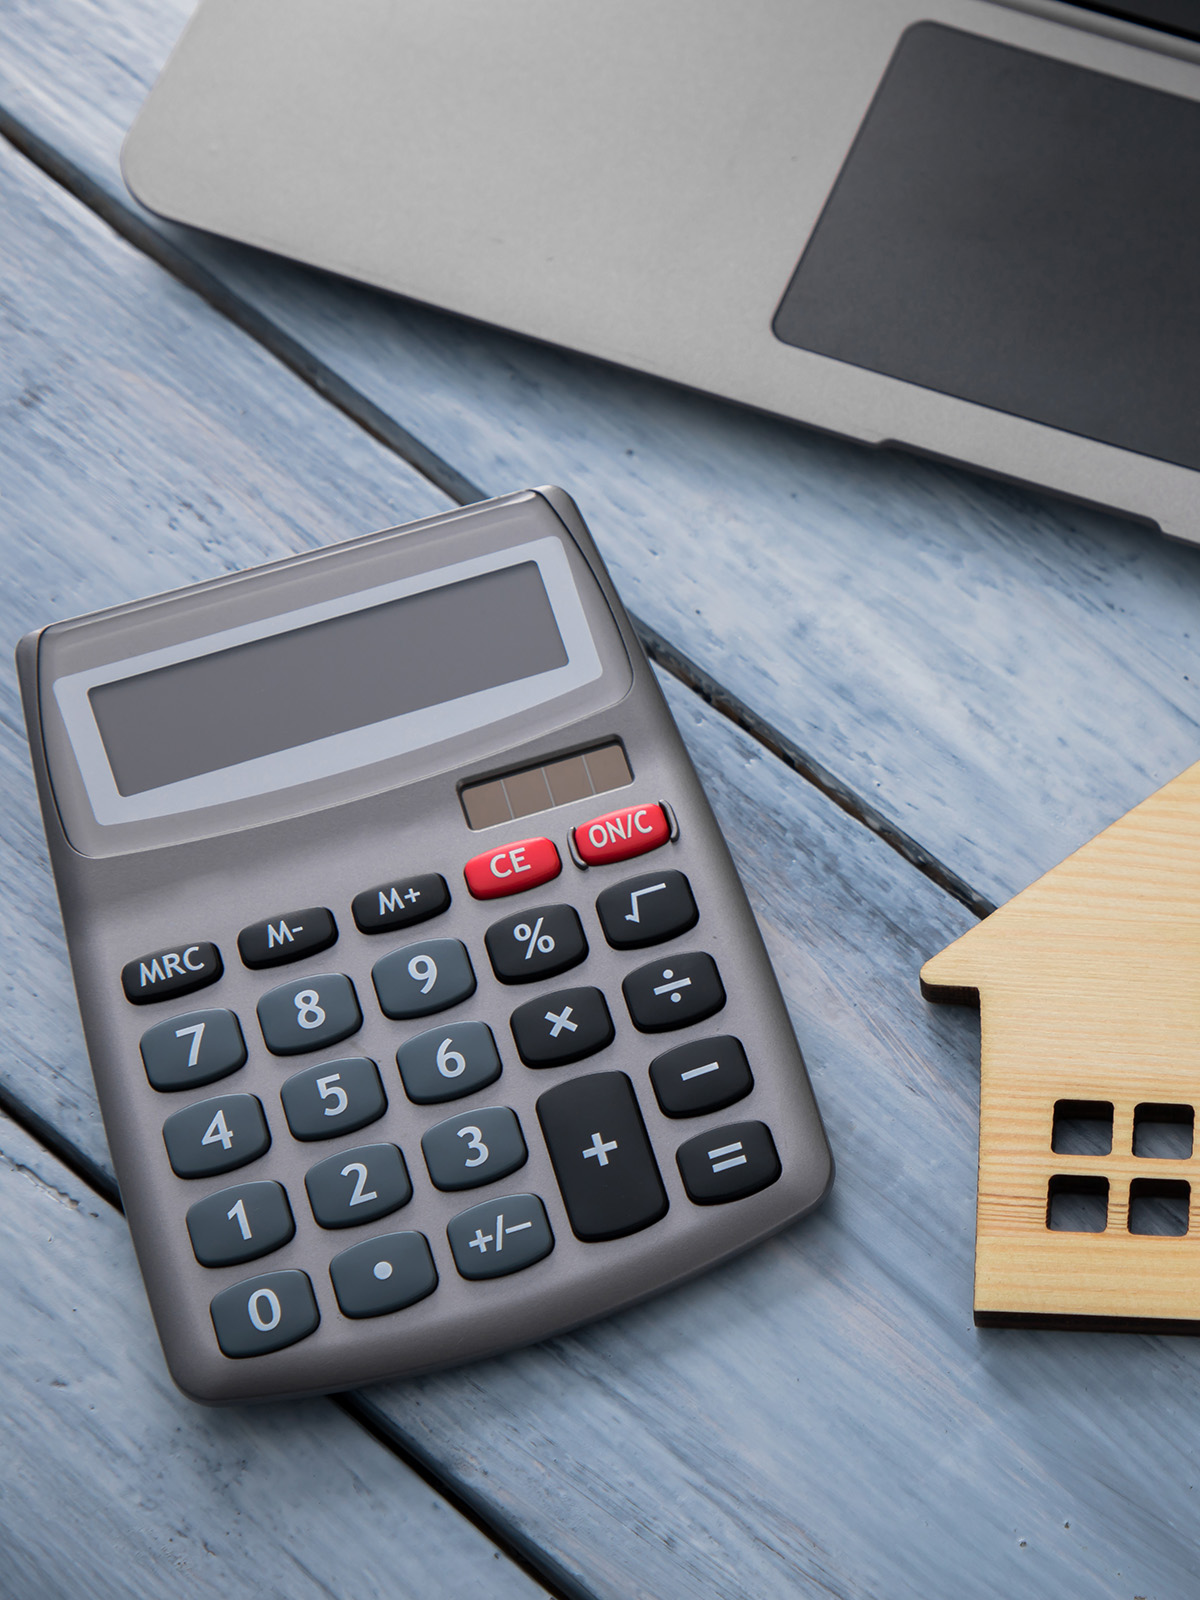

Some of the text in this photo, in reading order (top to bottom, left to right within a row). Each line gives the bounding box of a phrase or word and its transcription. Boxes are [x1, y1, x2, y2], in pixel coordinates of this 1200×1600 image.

[587, 809, 654, 849] ON/C
[489, 847, 532, 879] CE
[377, 887, 421, 916] M+
[267, 920, 304, 949] M-
[139, 946, 205, 988] MRC
[408, 954, 438, 994] 9
[294, 989, 326, 1029] 8
[175, 1022, 206, 1067] 7
[436, 1037, 466, 1078] 6
[316, 1072, 348, 1116] 5
[201, 1109, 234, 1150] 4
[456, 1125, 489, 1167] 3
[340, 1162, 378, 1206] 2
[227, 1198, 253, 1240] 1
[469, 1213, 532, 1253] +/-
[248, 1288, 282, 1332] 0
